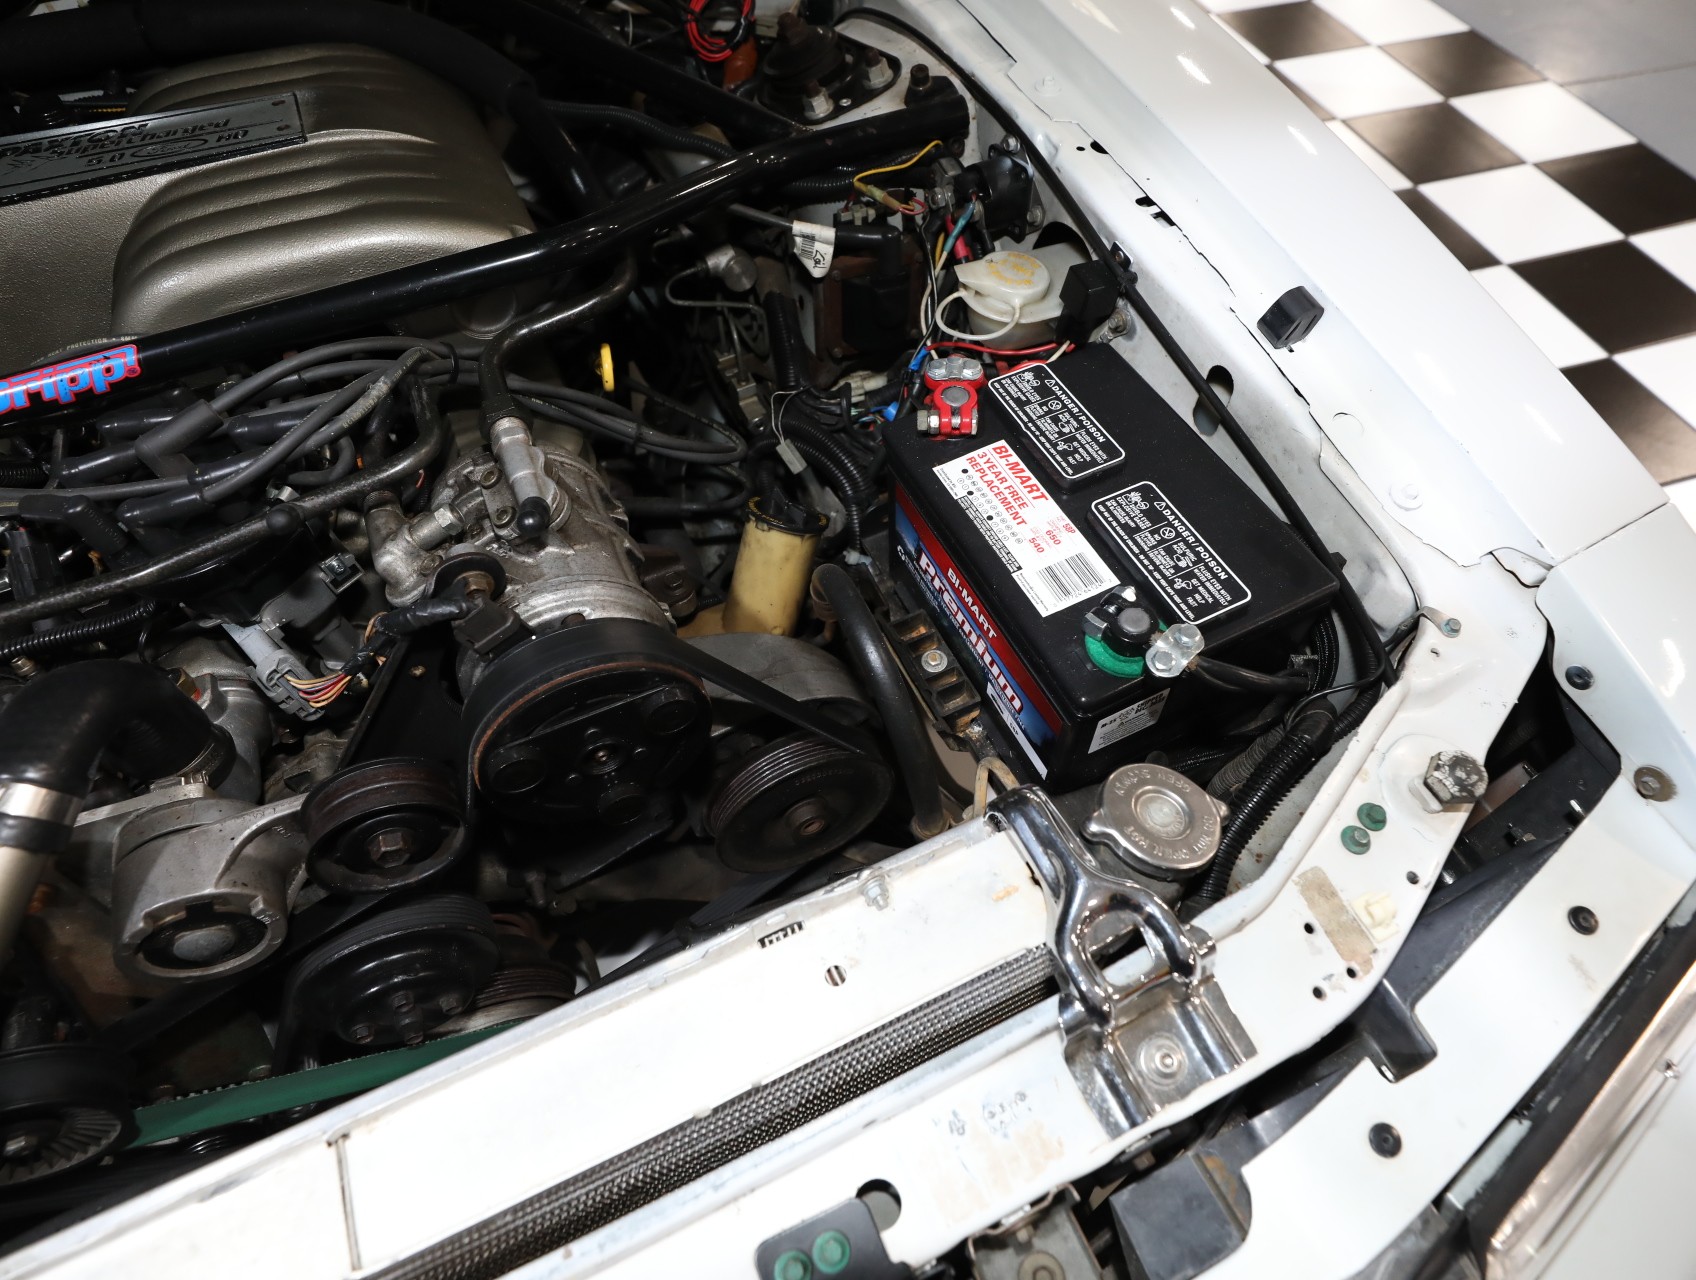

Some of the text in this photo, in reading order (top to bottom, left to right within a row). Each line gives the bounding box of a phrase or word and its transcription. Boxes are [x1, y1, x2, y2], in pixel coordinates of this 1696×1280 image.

[965, 455, 1027, 527] REPLACEMENT
[976, 451, 988, 459] 3
[982, 457, 1008, 484] YEAR
[1003, 484, 1029, 510] FREE
[992, 444, 1049, 502] BI-MART
[1028, 537, 1045, 553] 540
[1044, 529, 1061, 545] 650
[1190, 578, 1214, 603] GET MEDICAL
[1193, 593, 1205, 604] HELP
[1198, 565, 1232, 601] FLUSH EYES WITH
[947, 567, 998, 639] BI-MART
[1186, 596, 1198, 607] FAST
[919, 551, 1023, 715] Premium
